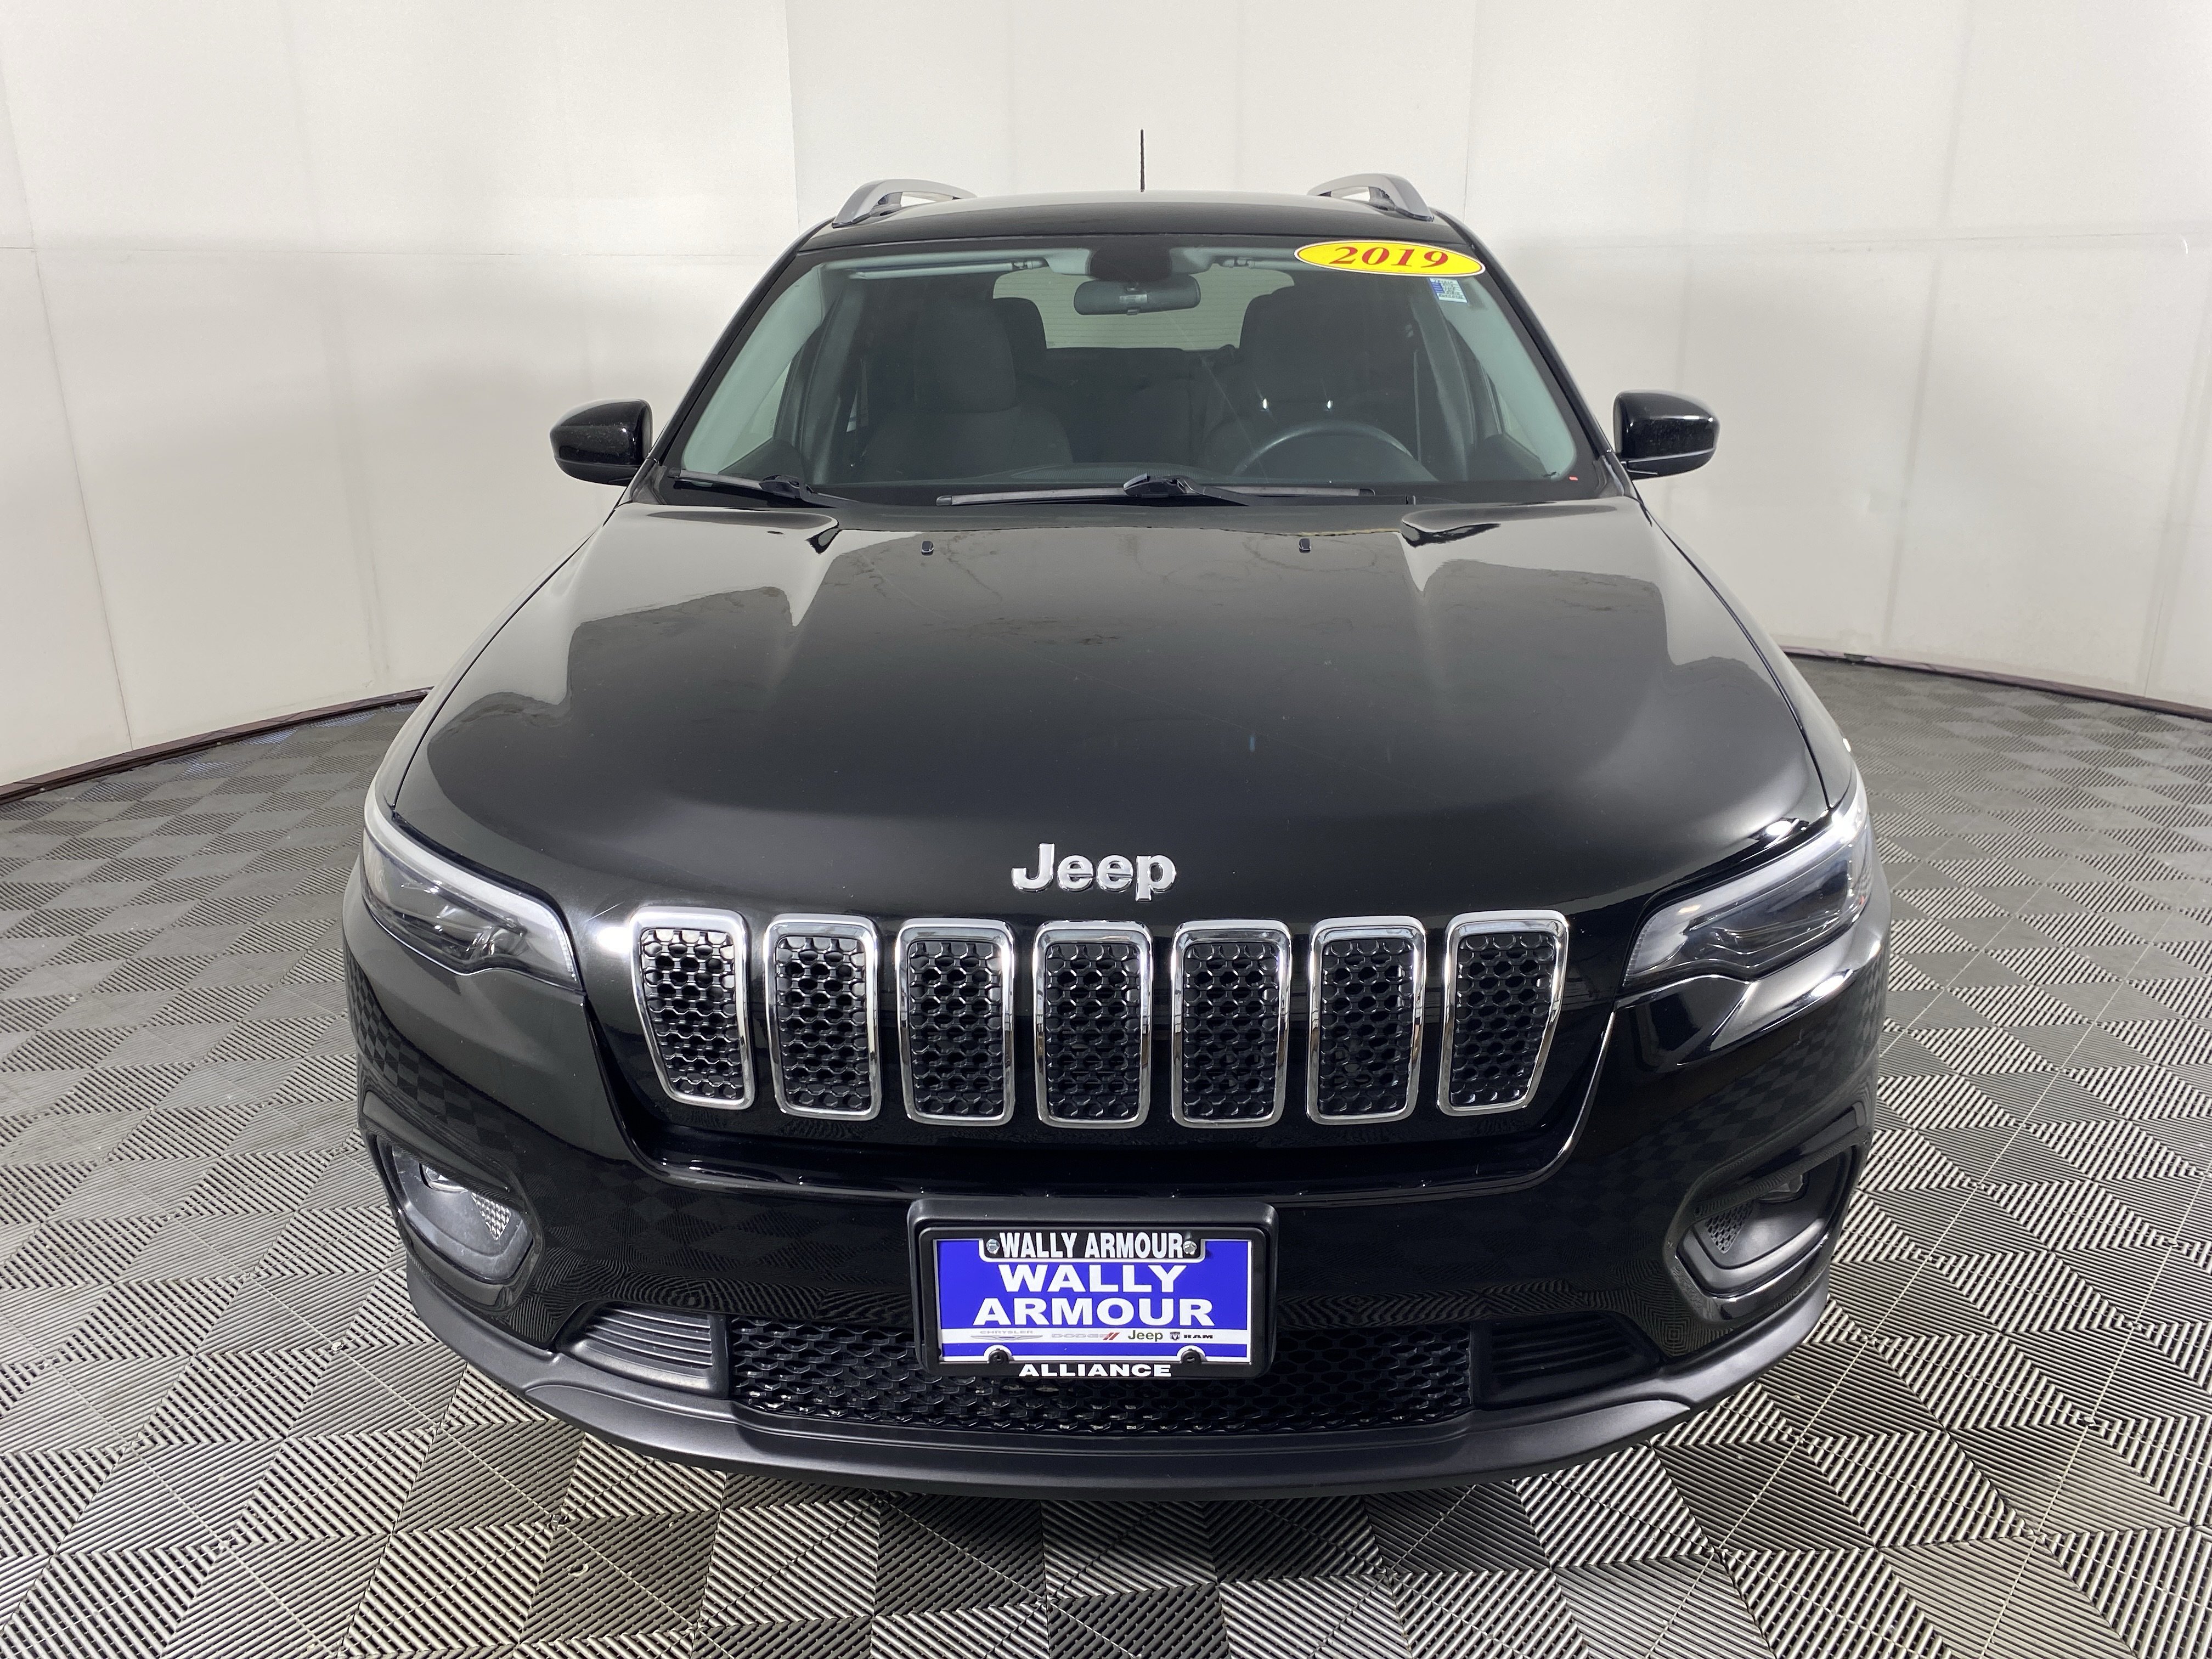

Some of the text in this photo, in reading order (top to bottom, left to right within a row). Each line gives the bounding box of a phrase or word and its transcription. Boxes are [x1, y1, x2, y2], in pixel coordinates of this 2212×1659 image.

[1328, 246, 1449, 268] 2019
[1011, 843, 1177, 901] Jeep
[1000, 1233, 1183, 1258] WALLY ARMOUR
[998, 1264, 1187, 1293] WALLY
[973, 1297, 1215, 1326] ARMOUR
[1128, 1330, 1163, 1342] Jeep
[1019, 1364, 1172, 1377] ALLIANCE
